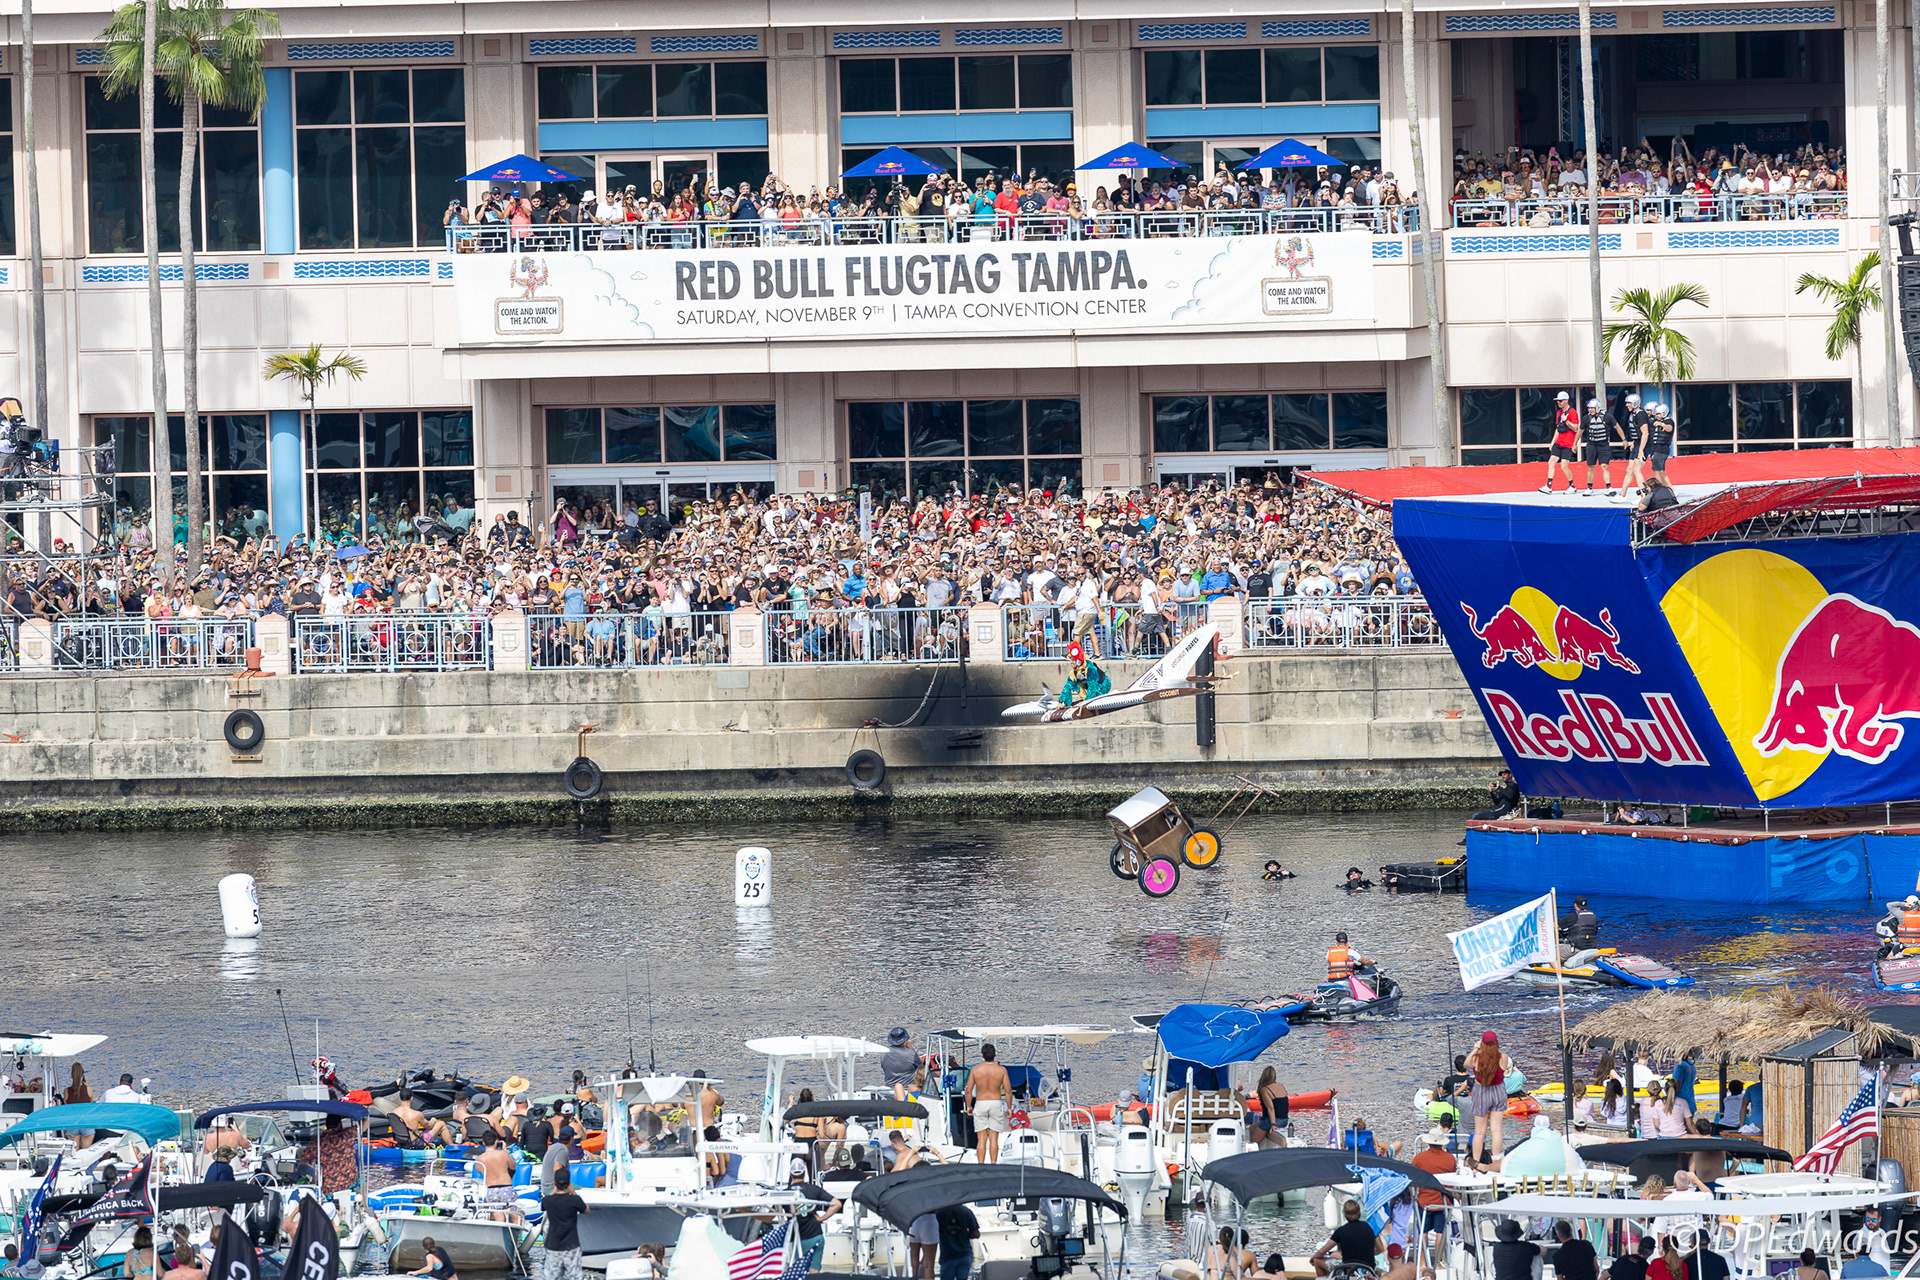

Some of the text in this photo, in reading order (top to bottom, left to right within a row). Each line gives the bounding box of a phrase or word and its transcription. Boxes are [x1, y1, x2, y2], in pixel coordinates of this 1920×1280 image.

[675, 249, 1148, 301] RED BULL FLUGTAG TAMPA.
[1268, 287, 1326, 296] COME AND WATCH
[1278, 296, 1317, 305] THE ACTION.
[500, 307, 557, 316] COME AND WATCH
[676, 310, 760, 326] SATURDAY,
[766, 306, 857, 324] NOVEMBER
[904, 305, 958, 320] TAMPA
[963, 301, 1079, 318] CONVENTION
[1085, 299, 1147, 315] CENTER
[510, 316, 548, 325] THE ACTION.
[1185, 637, 1199, 652] PIRATES
[1159, 689, 1180, 698] COCONUT
[743, 882, 765, 898] 25'
[1455, 907, 1538, 965] UNBURN
[1463, 936, 1540, 979] YOUR SUNBURN
[120, 1199, 144, 1208] BACK
